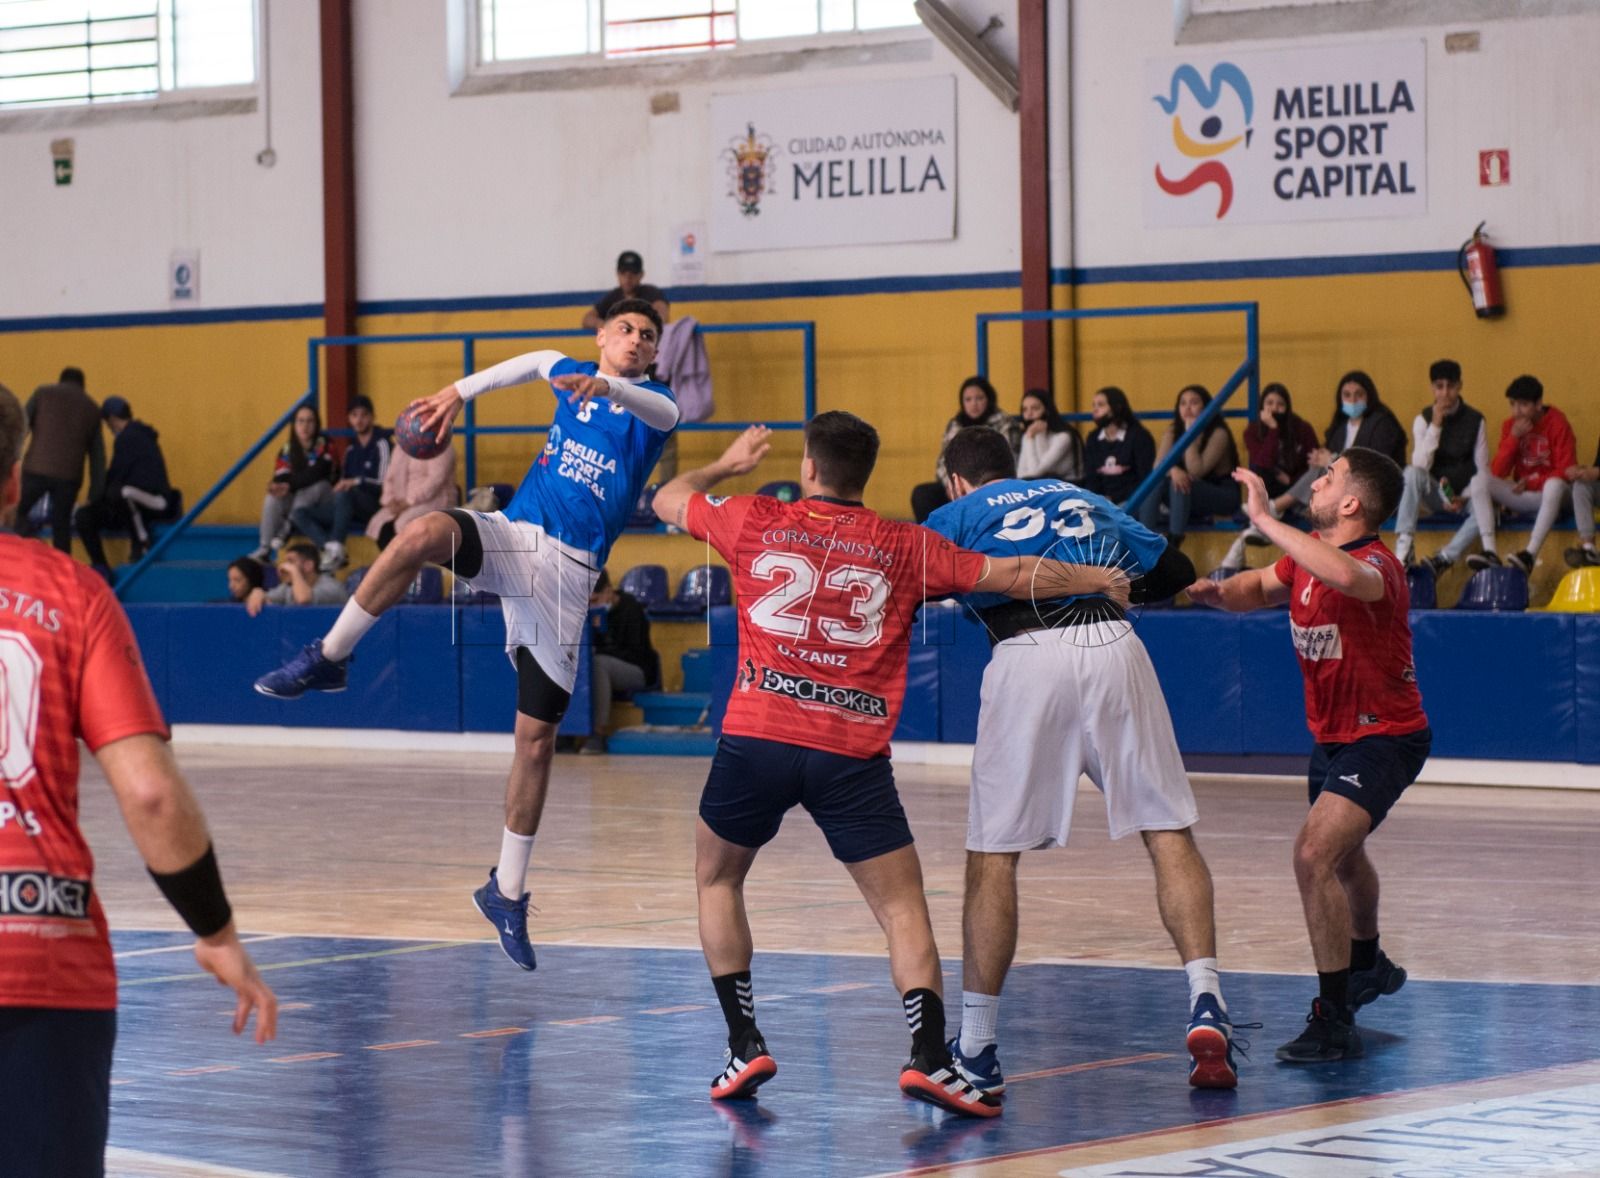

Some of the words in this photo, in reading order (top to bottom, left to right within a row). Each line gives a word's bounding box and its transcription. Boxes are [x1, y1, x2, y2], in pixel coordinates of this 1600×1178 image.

[1273, 80, 1415, 121] MELILLA
[788, 135, 847, 155] CIUDAD
[851, 128, 946, 150] AUTÓNOMA
[1274, 122, 1388, 161] SPORT
[793, 154, 946, 201] MELILLA
[1273, 161, 1416, 201] CAPITAL
[560, 451, 603, 480] SPORT
[562, 438, 617, 475] MELILLA
[986, 482, 1082, 507] MIRALLE
[762, 529, 894, 567] CORAZONISTAS
[747, 550, 892, 648] 23
